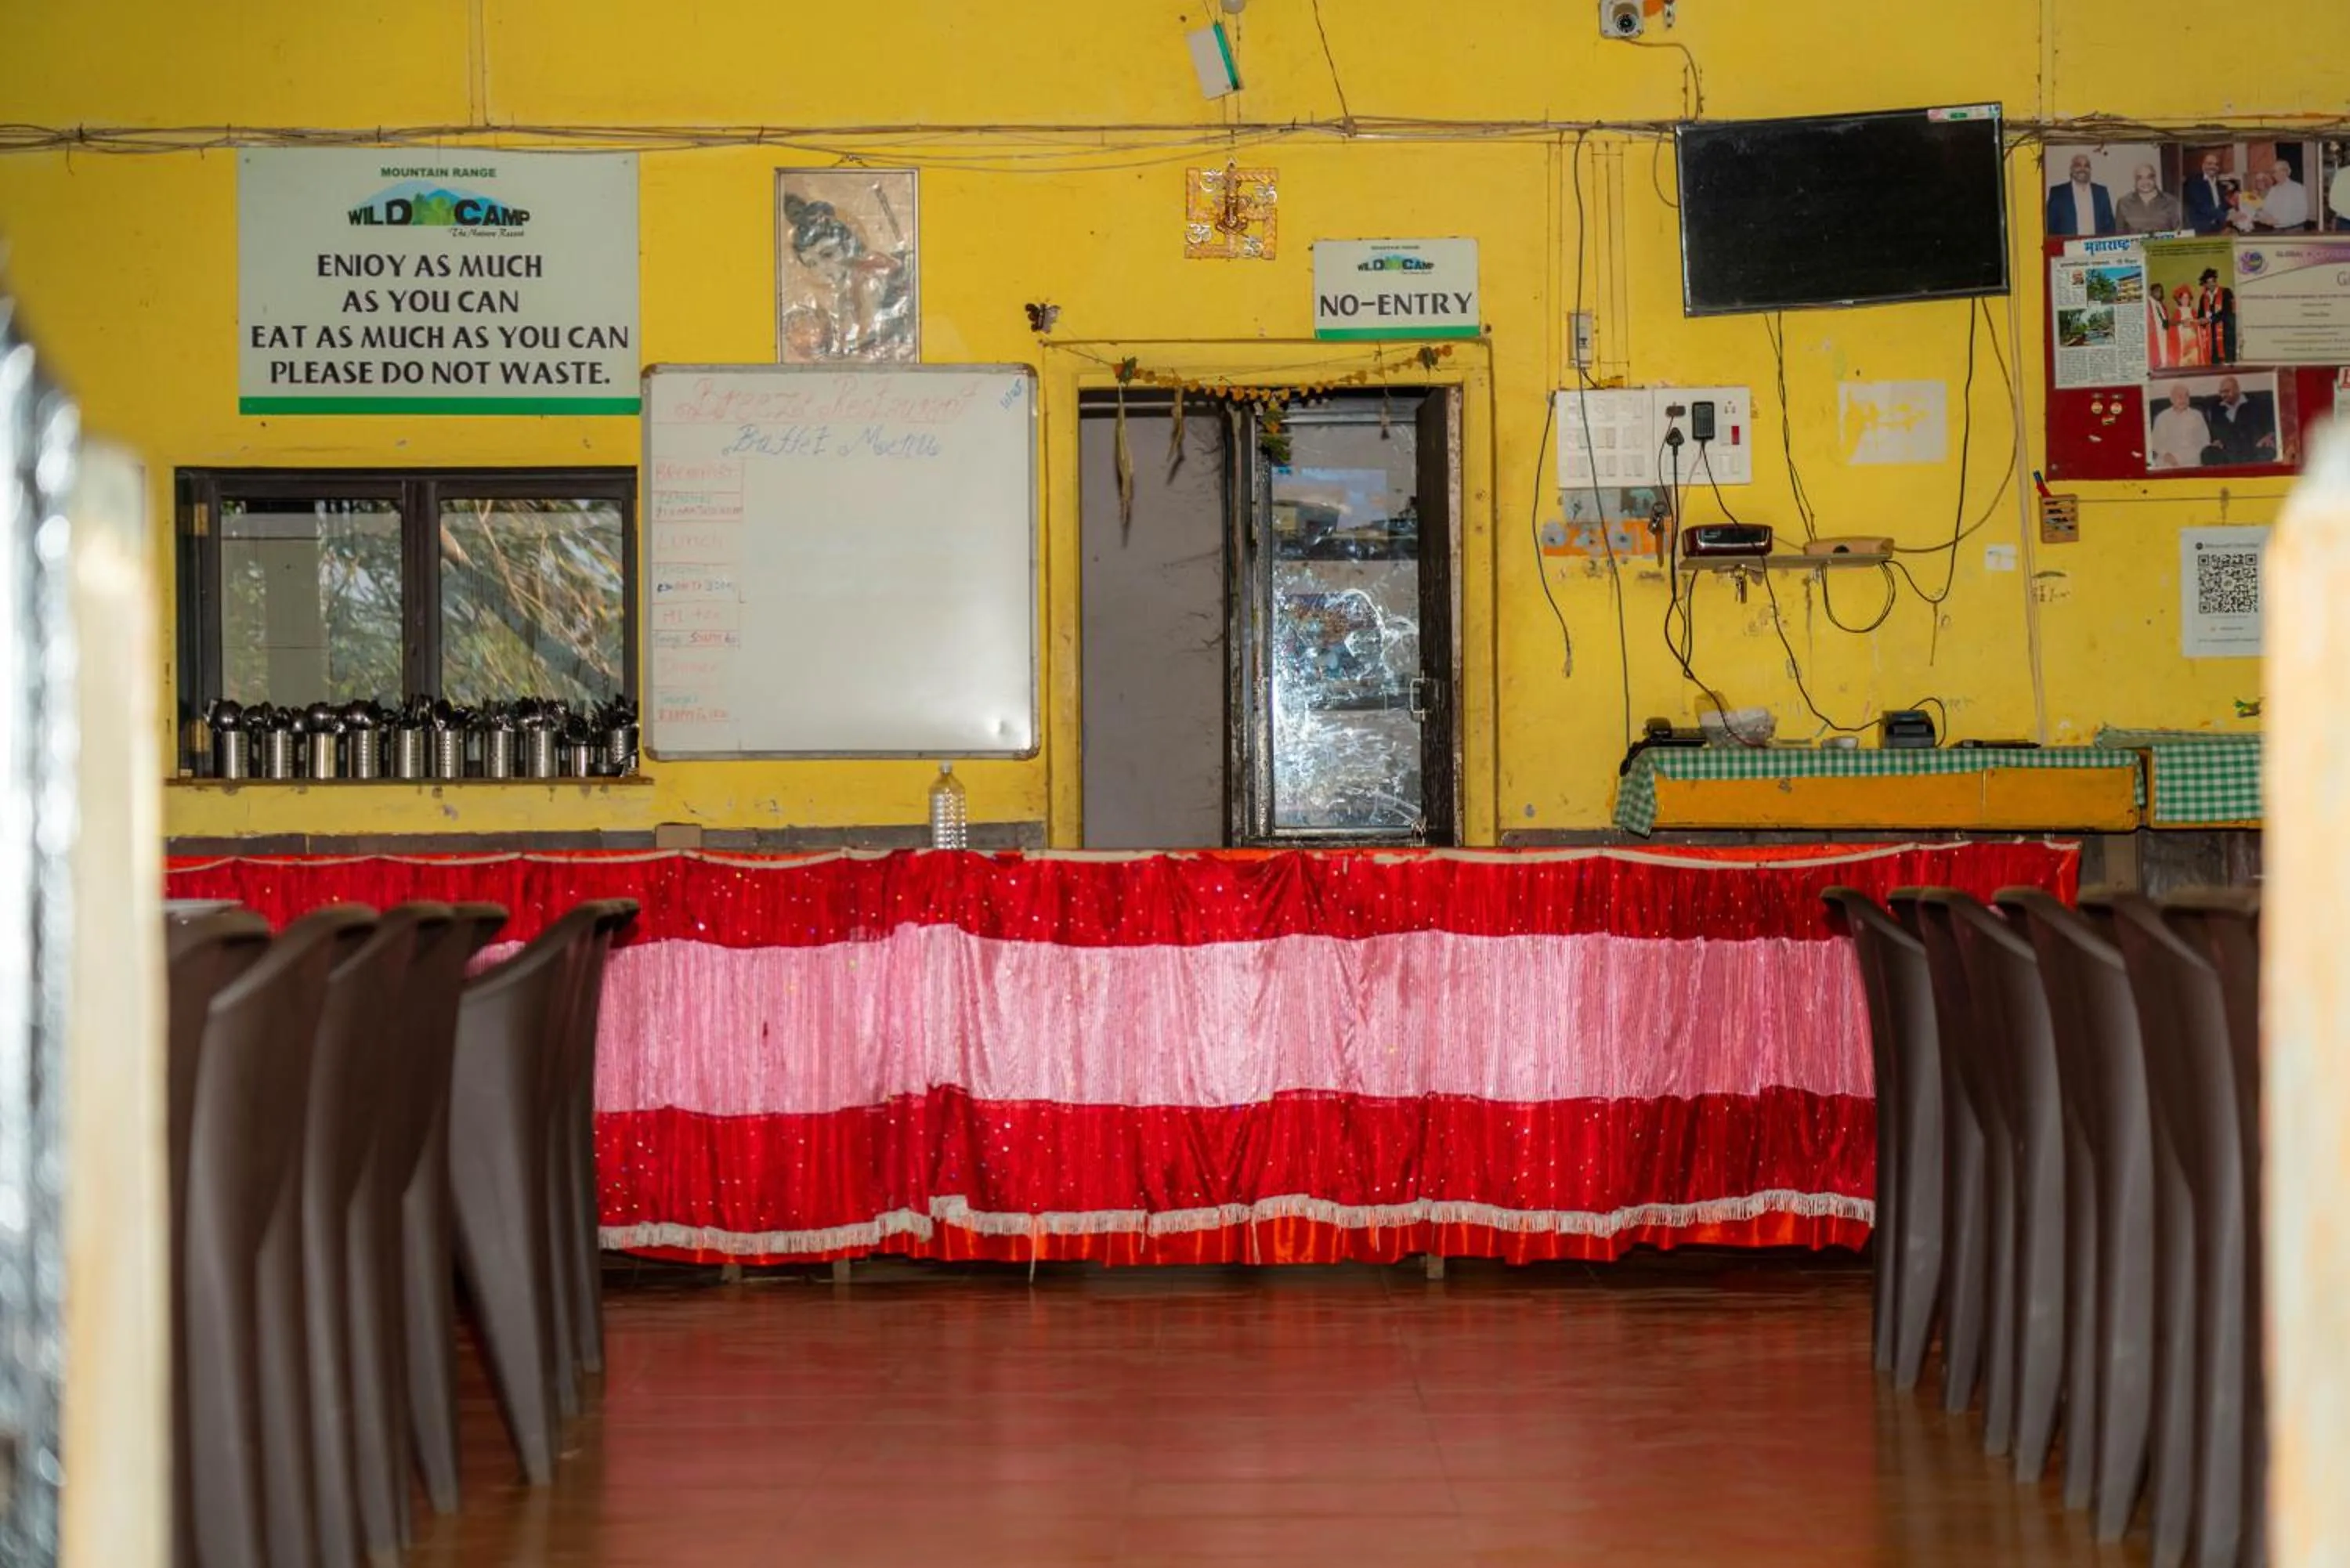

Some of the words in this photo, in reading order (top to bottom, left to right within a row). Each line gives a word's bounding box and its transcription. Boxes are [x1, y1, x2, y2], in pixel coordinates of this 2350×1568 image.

[380, 167, 450, 178] MOUNTAIN
[452, 167, 497, 178] RANGE
[348, 198, 413, 226] WILD
[454, 198, 530, 226] CAMP
[414, 254, 451, 277] AS
[459, 254, 542, 277] MUCH
[342, 290, 379, 313] AS
[387, 290, 450, 313] YOU
[457, 290, 519, 313] CAN
[1319, 292, 1473, 317] NO-ENTRY
[251, 325, 308, 349] EAT
[316, 325, 354, 349] AS
[360, 325, 444, 349] MUCH
[452, 325, 490, 349] AS
[497, 325, 560, 349] YOU
[567, 325, 629, 349] CAN
[270, 360, 374, 385] PLEASE
[381, 360, 425, 385] DO
[432, 360, 491, 385] NOT
[499, 360, 611, 385] WASTE.
